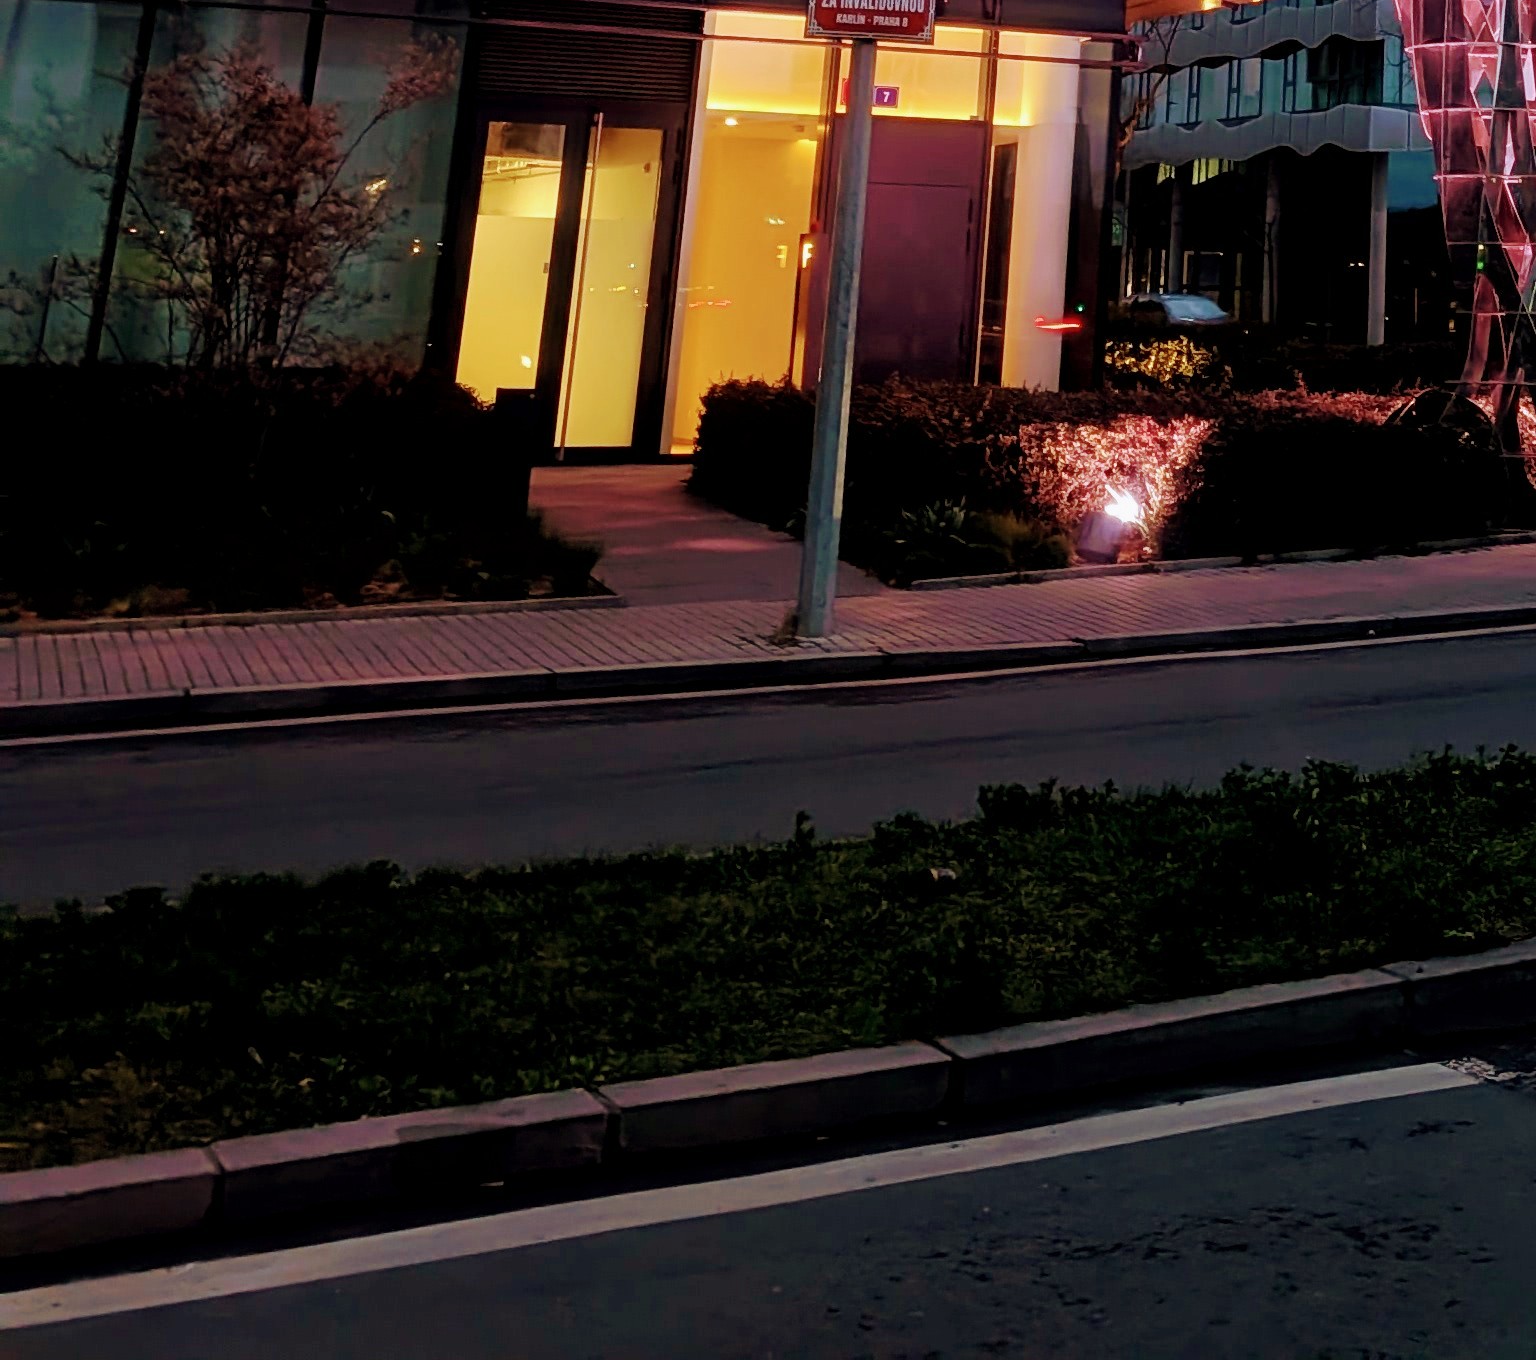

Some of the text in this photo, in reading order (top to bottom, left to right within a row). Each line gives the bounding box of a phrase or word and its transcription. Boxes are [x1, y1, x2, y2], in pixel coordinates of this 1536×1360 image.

[836, 12, 866, 25] KARLÍN
[873, 15, 900, 27] PRAHA
[883, 91, 891, 103] 7
